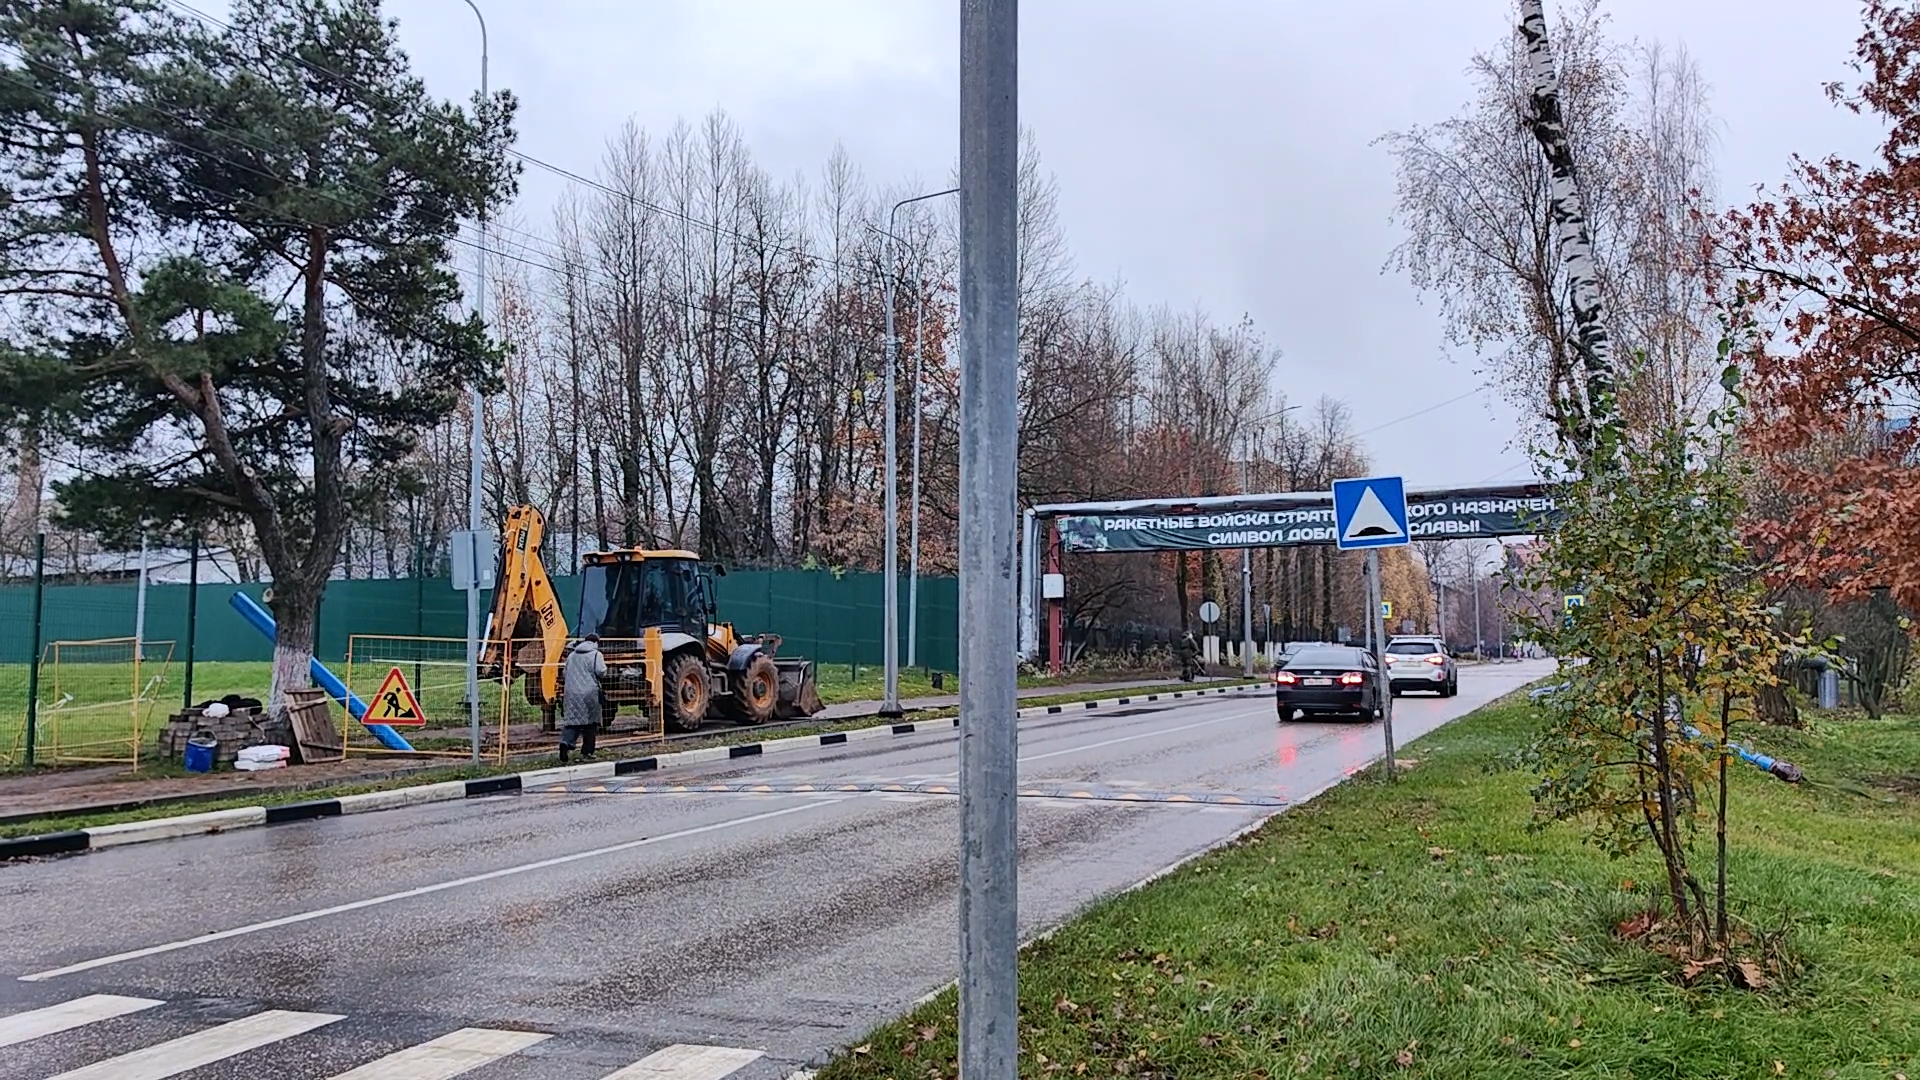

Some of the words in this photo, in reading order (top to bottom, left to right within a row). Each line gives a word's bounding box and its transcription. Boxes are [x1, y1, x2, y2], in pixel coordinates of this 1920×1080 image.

[1104, 516, 1194, 531] РАКЕТНЫЕ
[1198, 512, 1269, 527] ВОЙСКА
[1452, 498, 1559, 514] НАЗНАЧЕН
[1208, 530, 1283, 545] СИМВОЛ
[1409, 519, 1480, 535] СЛАВЫ!
[541, 604, 554, 627] JCB
